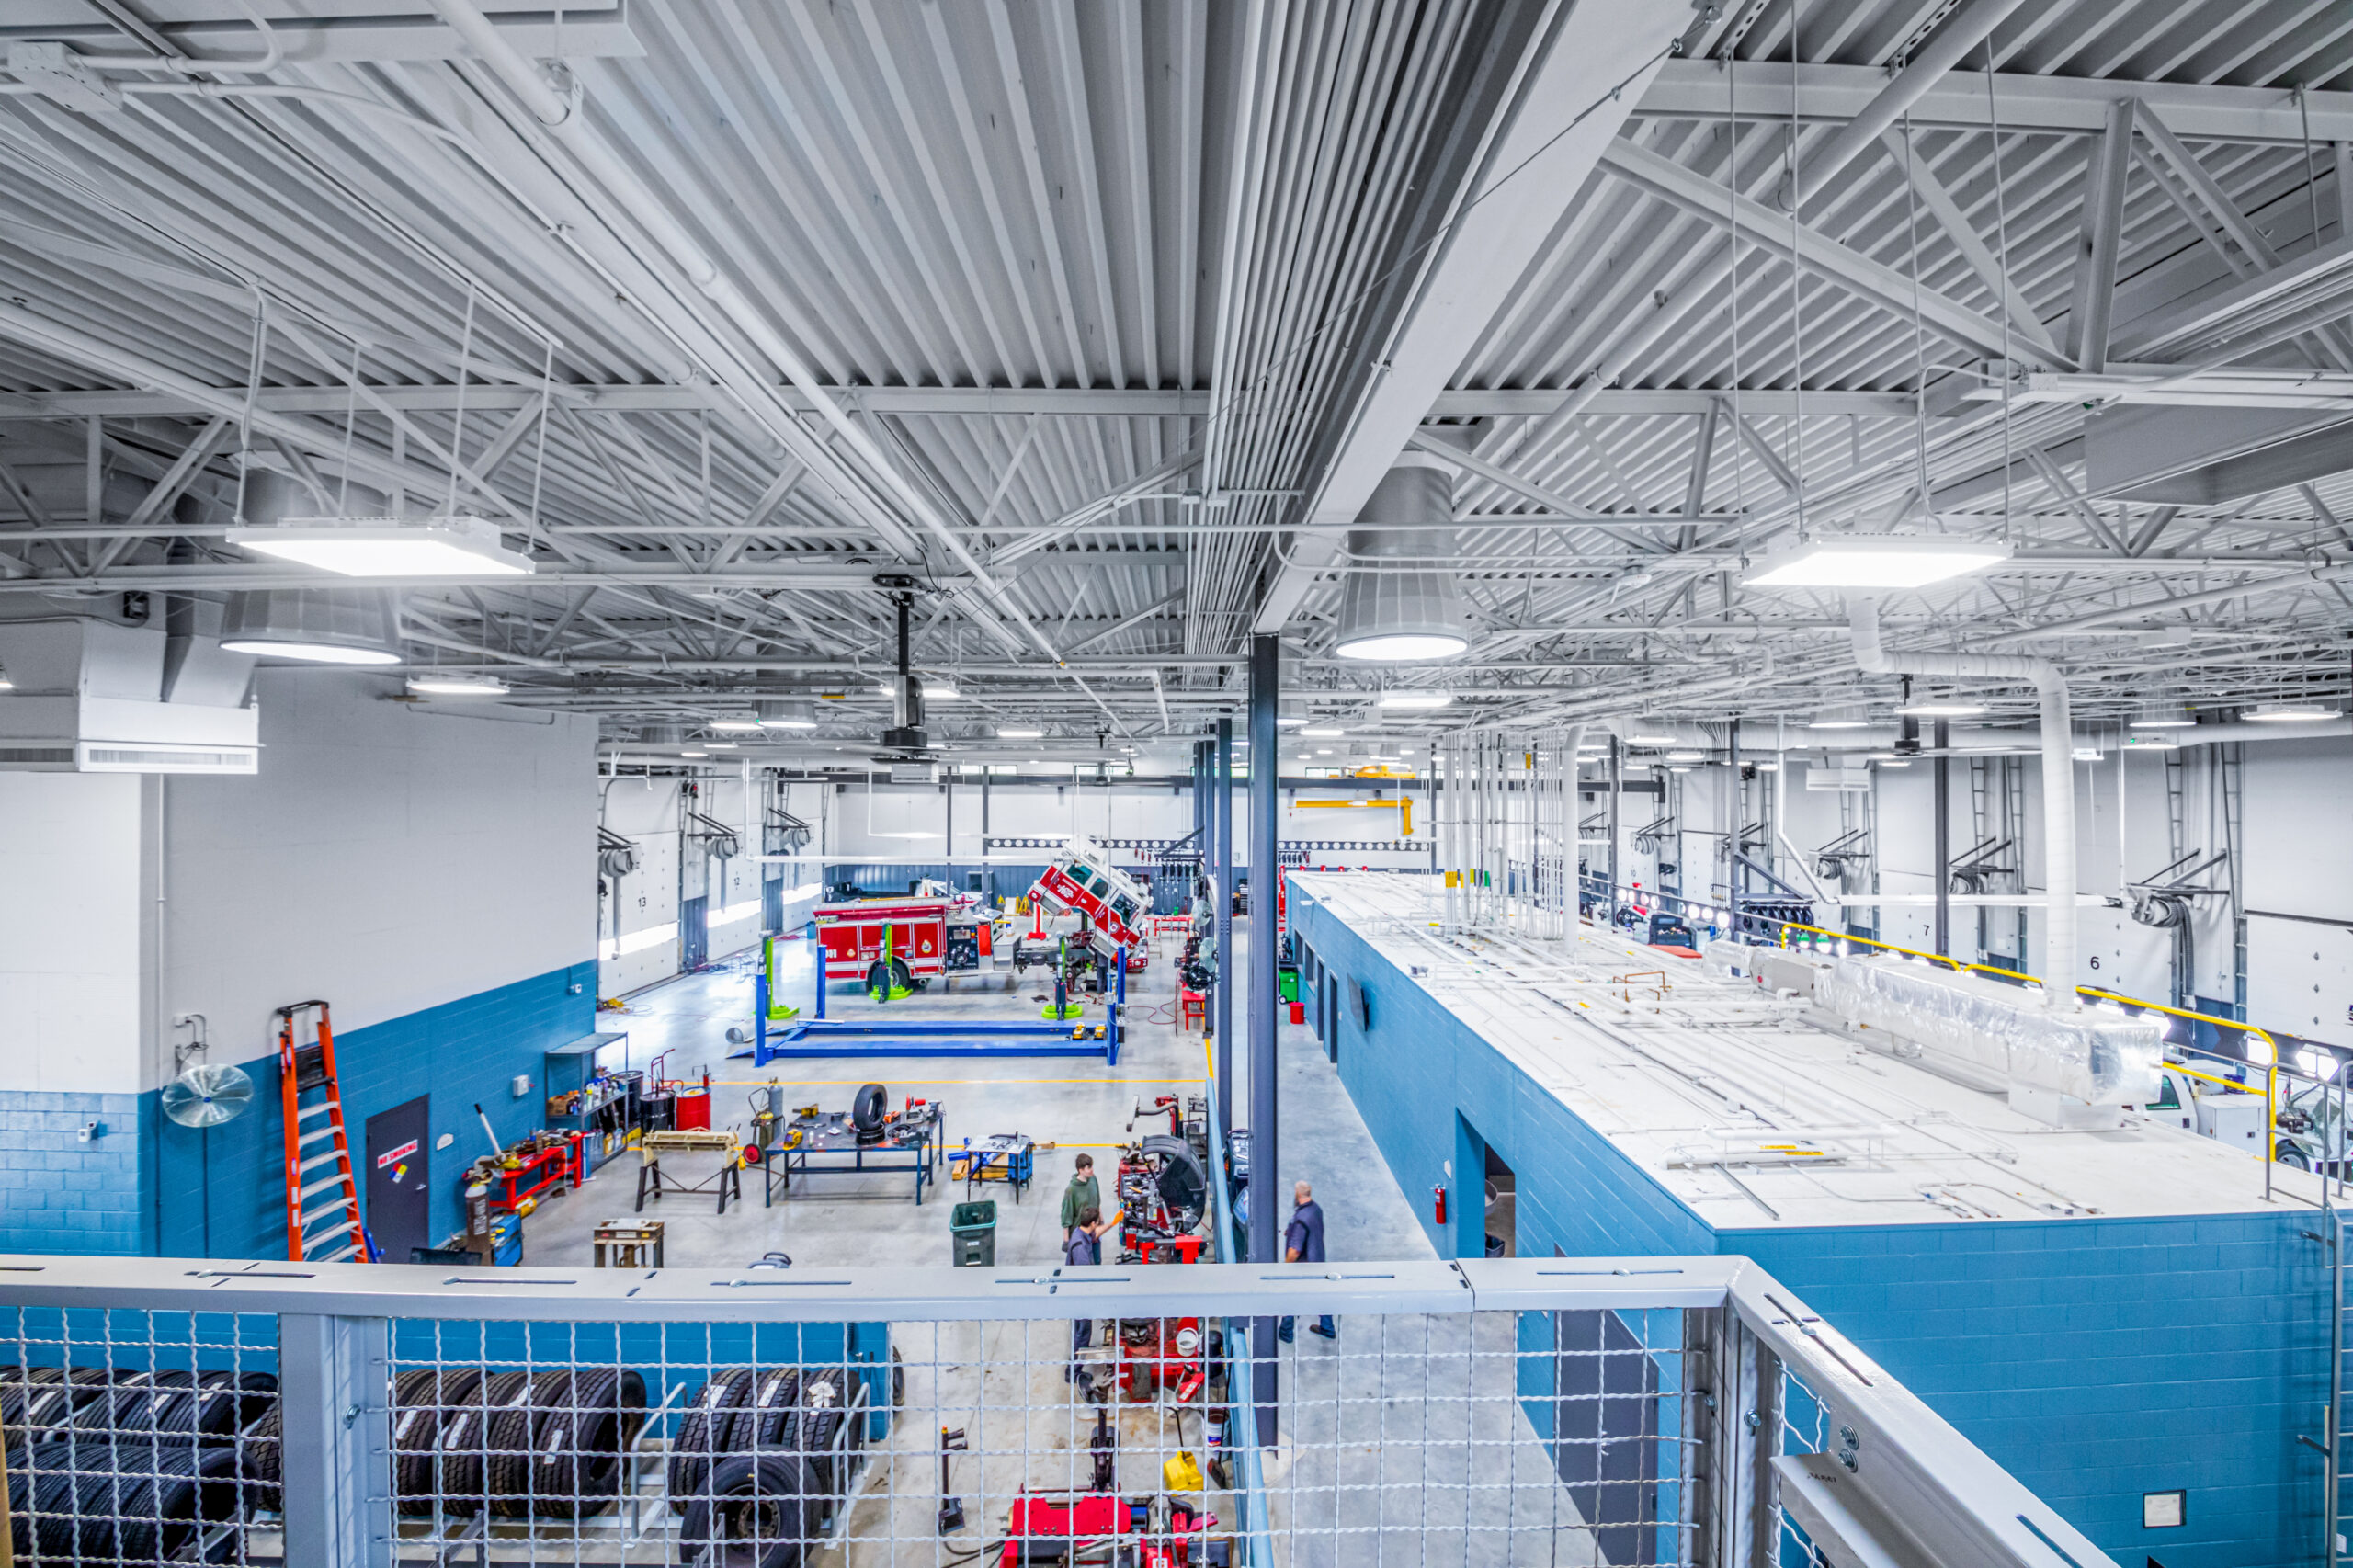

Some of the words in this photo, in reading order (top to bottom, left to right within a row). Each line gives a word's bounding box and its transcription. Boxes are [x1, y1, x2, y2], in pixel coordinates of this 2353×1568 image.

[734, 877, 740, 886] 12
[638, 896, 647, 908] 13
[1923, 924, 1930, 936] 7
[2090, 955, 2100, 971] 6
[378, 1155, 388, 1165] NO
[389, 1142, 417, 1161] SMOKING
